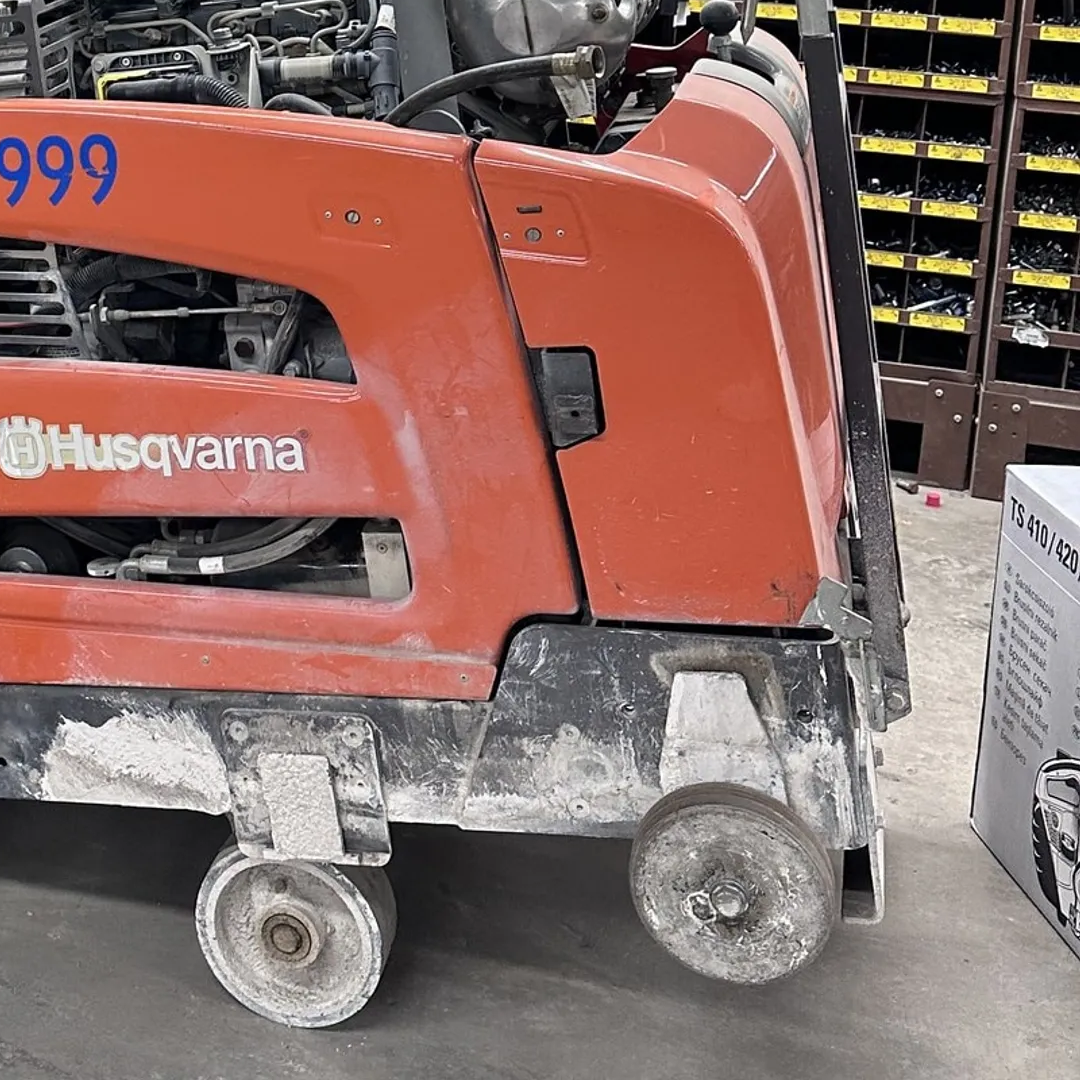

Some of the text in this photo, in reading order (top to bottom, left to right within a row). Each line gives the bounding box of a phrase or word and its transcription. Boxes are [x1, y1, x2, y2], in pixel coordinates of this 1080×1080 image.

[45, 424, 306, 477] Husqvarna
[1010, 495, 1026, 528] TS
[1027, 514, 1048, 549] 410
